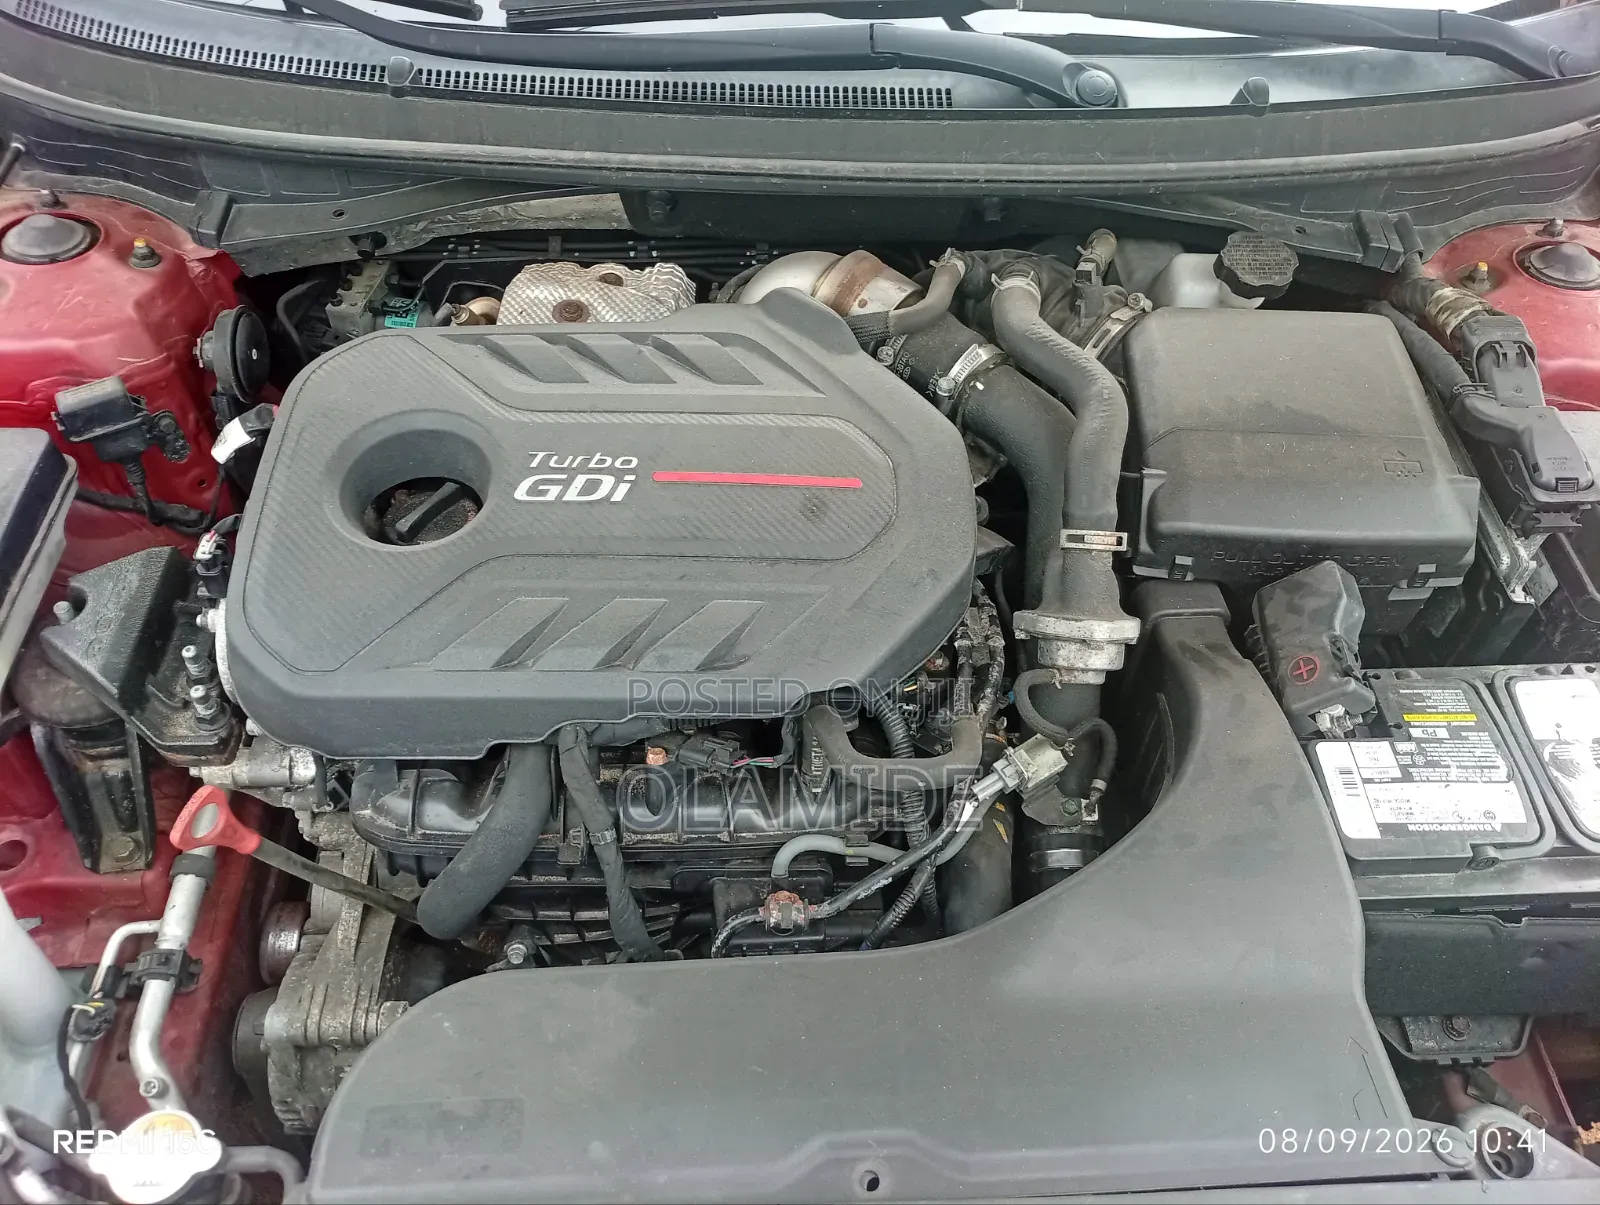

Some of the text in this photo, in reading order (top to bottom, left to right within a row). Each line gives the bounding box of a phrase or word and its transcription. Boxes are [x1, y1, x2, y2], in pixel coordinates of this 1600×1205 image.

[528, 451, 639, 469] Turbo
[513, 474, 637, 502] GDi
[1406, 822, 1494, 832] DANGER/POISON
